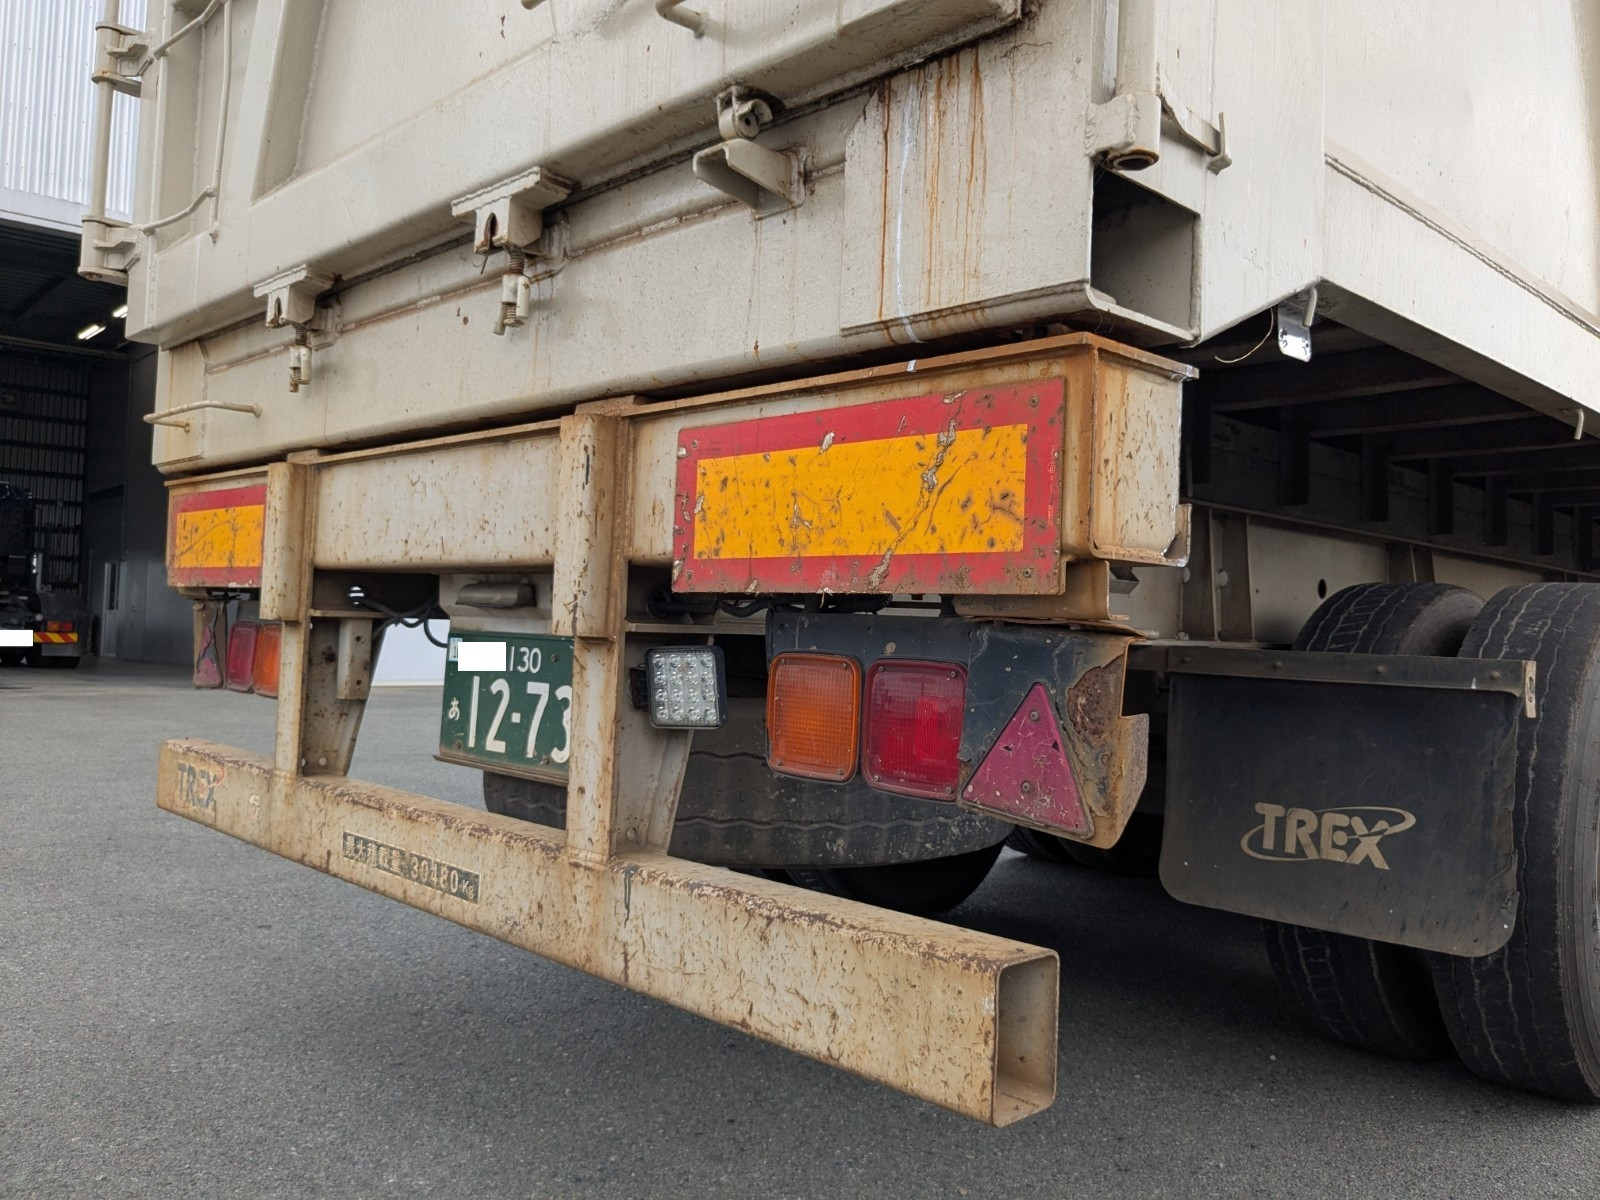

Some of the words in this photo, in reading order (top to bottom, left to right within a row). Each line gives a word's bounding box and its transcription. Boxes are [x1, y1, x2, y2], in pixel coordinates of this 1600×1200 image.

[509, 646, 542, 674] 130
[448, 697, 460, 721] あ
[1254, 801, 1391, 871] TREX
[345, 835, 401, 872] 最大積載量
